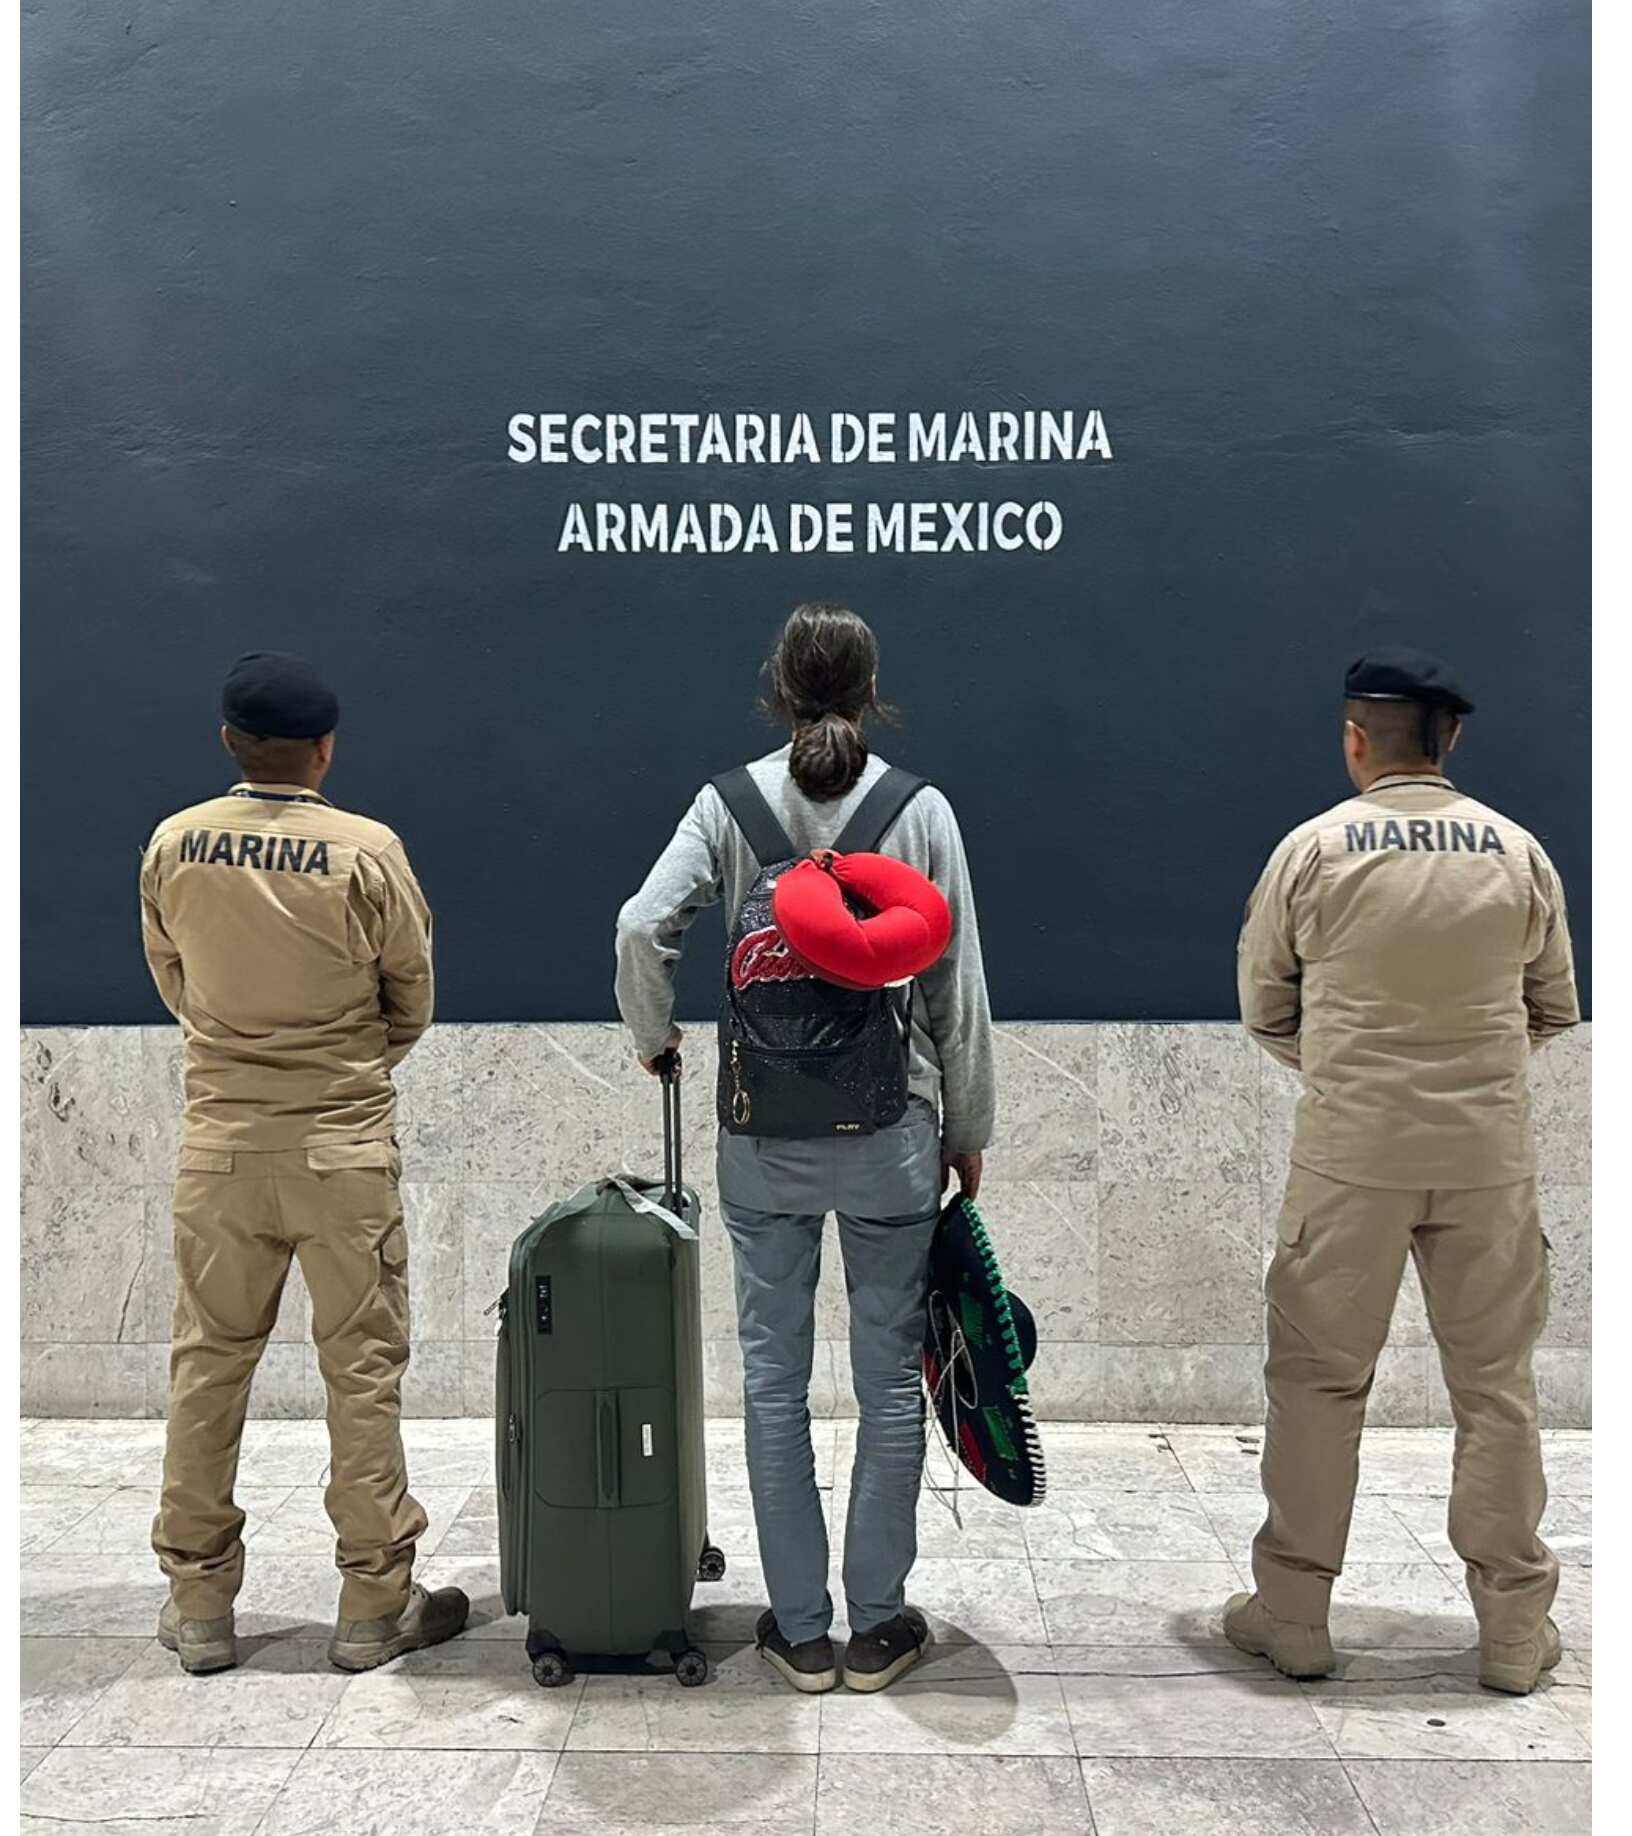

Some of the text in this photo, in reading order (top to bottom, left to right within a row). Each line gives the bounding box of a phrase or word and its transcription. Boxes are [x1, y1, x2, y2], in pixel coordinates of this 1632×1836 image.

[507, 409, 1113, 464] SECRETARIA DE MARINA
[558, 501, 1063, 553] ARMADA DE MEXICO
[179, 829, 330, 876] MARINA
[1344, 819, 1506, 855] MARINA
